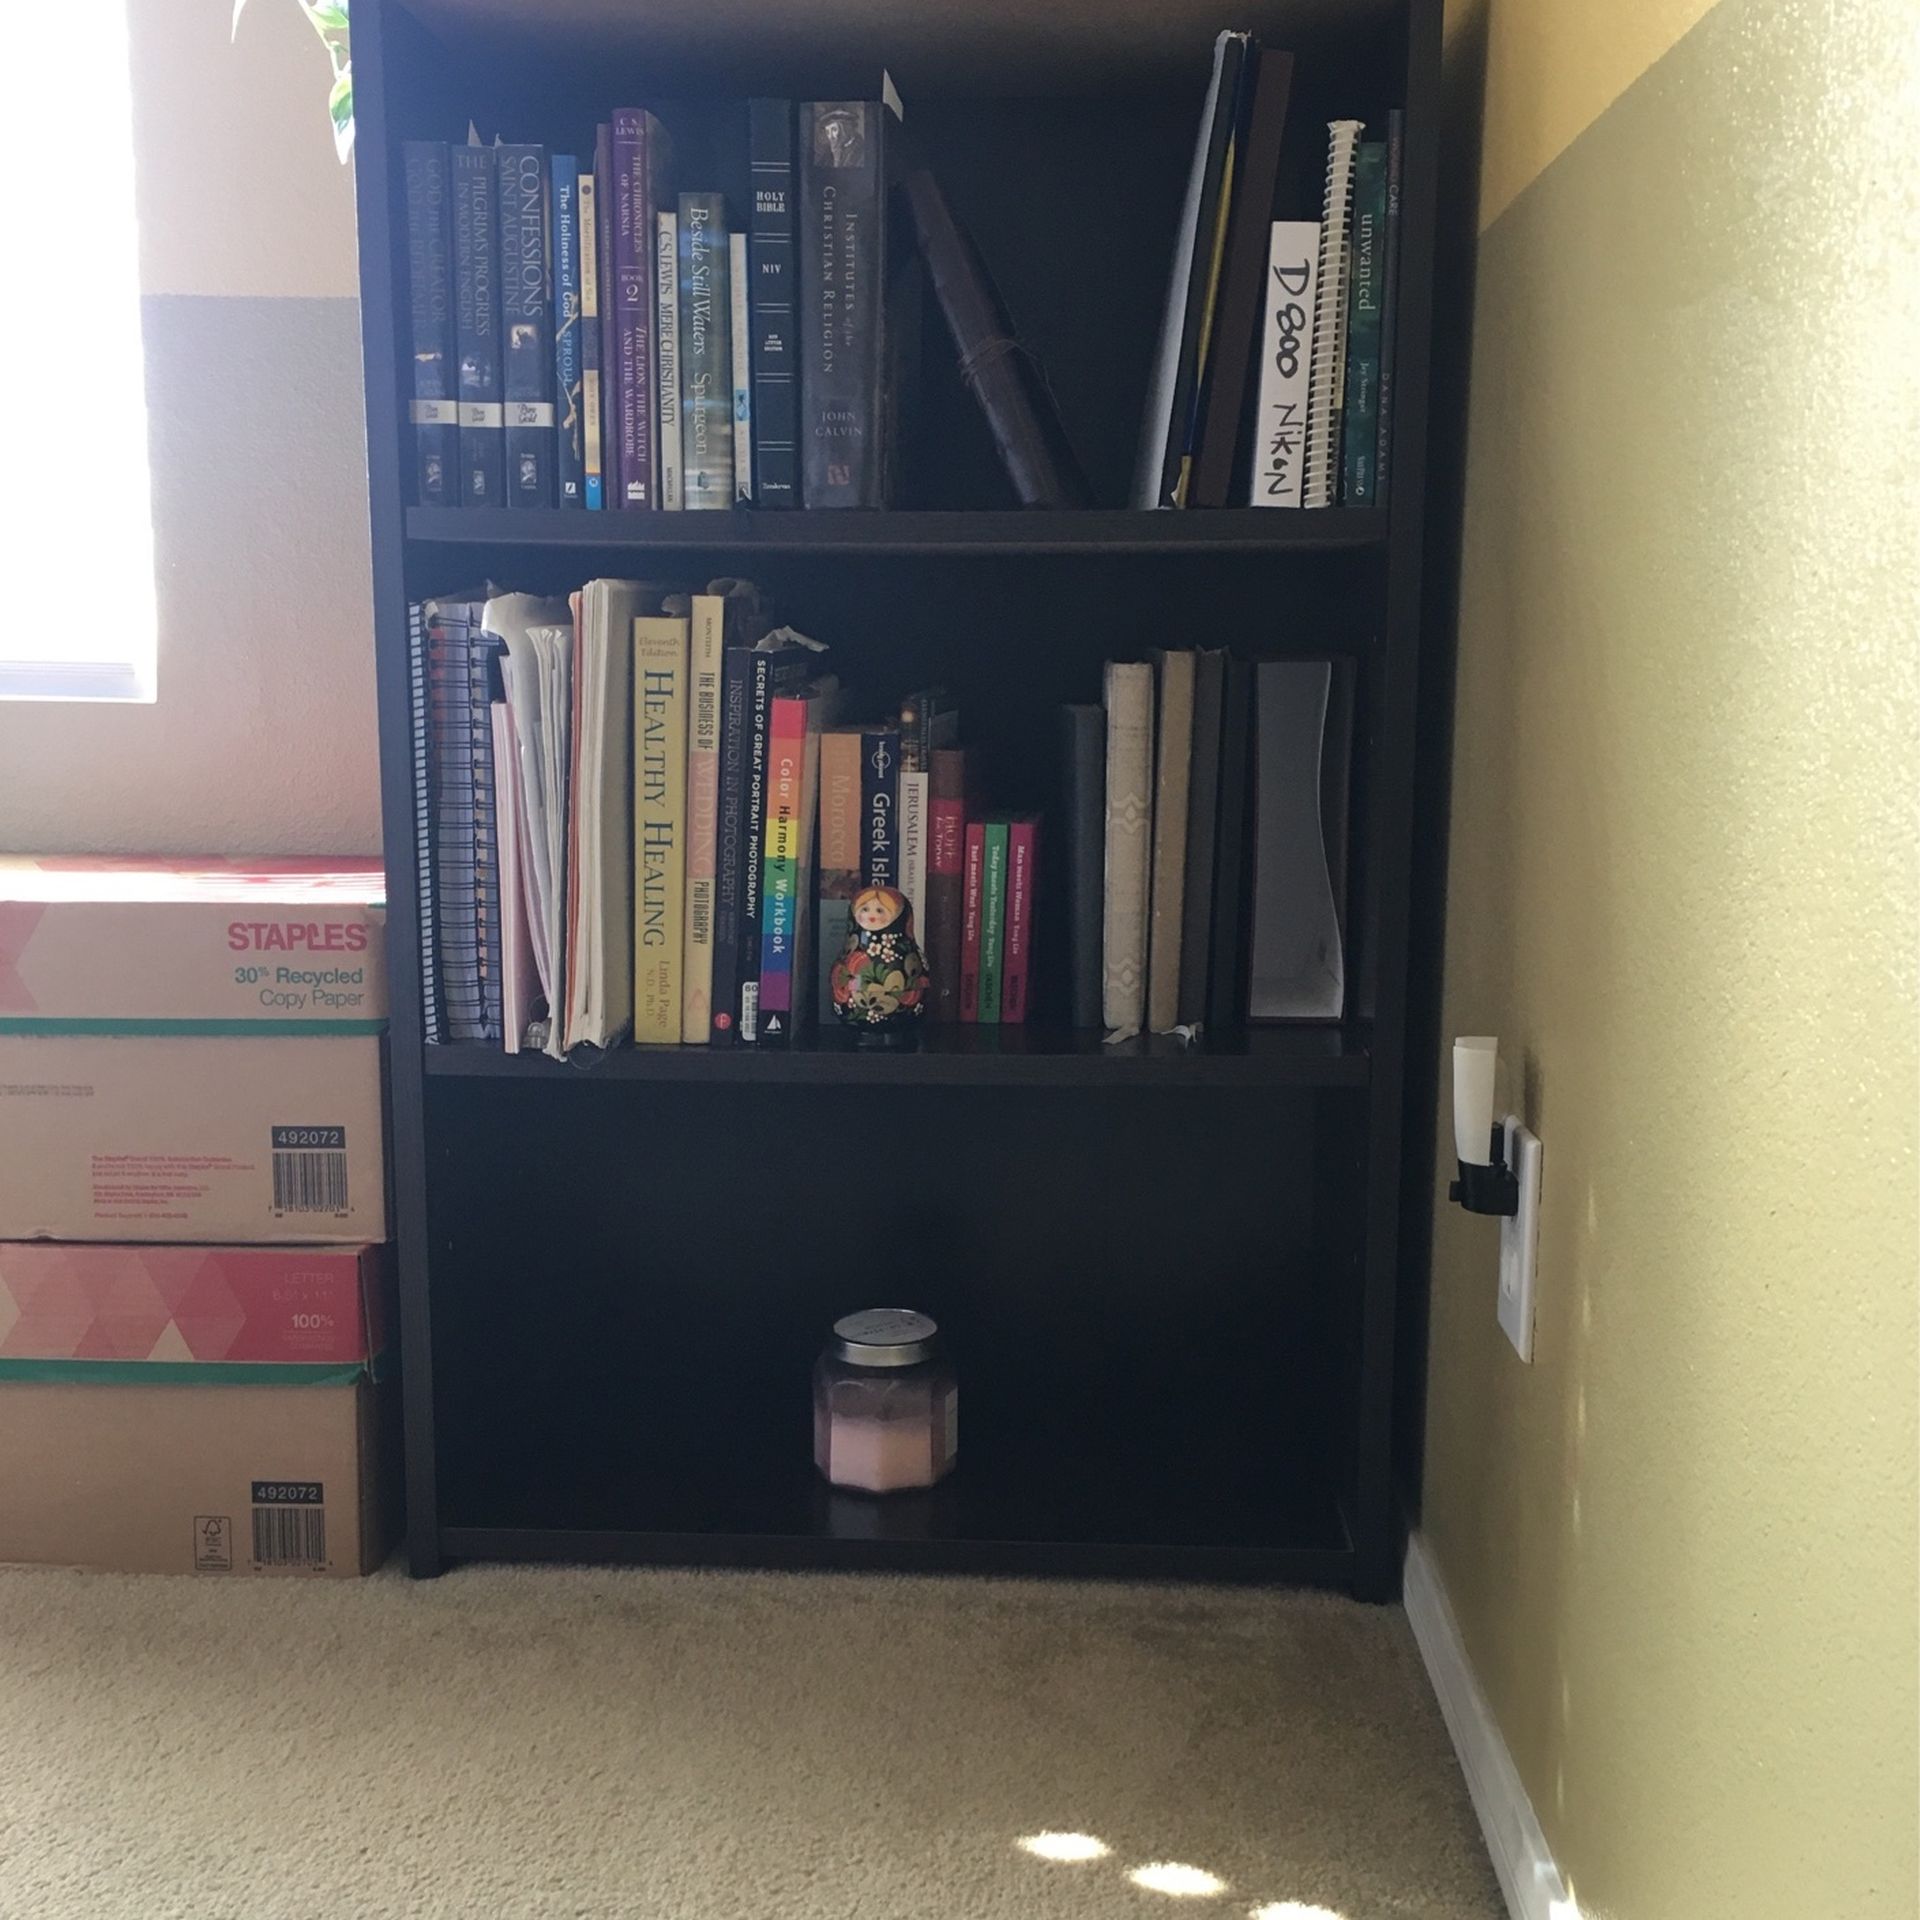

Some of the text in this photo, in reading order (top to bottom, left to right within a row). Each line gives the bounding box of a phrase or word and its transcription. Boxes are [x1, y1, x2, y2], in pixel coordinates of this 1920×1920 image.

[615, 127, 644, 136] LEWIS
[457, 154, 487, 169] THE
[426, 159, 442, 205] GOD
[756, 191, 785, 201] HOLY
[620, 173, 631, 236] OF NARNIA
[632, 155, 643, 253] THE CHRONICLES
[756, 202, 786, 212] BIBLE
[1388, 184, 1400, 217] CARE
[501, 155, 519, 316] SAINT AUGUSTINE
[519, 155, 543, 317] CONFESSIONS
[559, 185, 572, 318] The Holiness of God
[458, 183, 473, 330] IN MODERN ENGLISH
[660, 254, 673, 295] LEWIS
[762, 263, 782, 274] NIV
[845, 213, 858, 311] INSTITUTES
[1358, 213, 1376, 311] unwanted
[429, 239, 447, 323] CREATOR
[621, 273, 643, 282] BOOK
[626, 284, 640, 303] 2
[690, 207, 711, 355] Beside Still Waters
[822, 185, 836, 373] CHRISTIAN RELIGION
[474, 256, 490, 337] PROGRESS
[635, 326, 647, 353] THE
[561, 330, 574, 387] SPROUL
[661, 302, 676, 427] MERE CHRISTIANITY
[623, 328, 635, 458] AND THE WARDROBE
[636, 393, 646, 417] THE
[690, 372, 712, 455] Spurgeon
[815, 425, 863, 437] CALVIN
[822, 411, 856, 423] JOHN
[1377, 372, 1391, 480] DANA ADAMS
[636, 421, 647, 463] WITCH
[639, 636, 680, 646] Eleventh
[641, 647, 679, 657] Edition
[704, 617, 713, 659] MONTEITH
[726, 680, 743, 773] INSPIRATION
[725, 776, 738, 792] IN
[746, 659, 766, 919] SECRETS OF GREAT PORTRAIT PHOTOGRAPHY
[642, 668, 675, 948] HEALTHY HEALING
[692, 672, 715, 945] THE BUSINESS OF WEDDING PHOTOGRAPHY
[831, 775, 851, 863] Morocco
[872, 792, 891, 852] Greek
[906, 782, 920, 856] JERUSALEM
[722, 796, 737, 907] PHOTOGRAPHY
[773, 757, 794, 954] Color Harmony Workbook
[935, 832, 944, 868] TODAY
[944, 816, 958, 859] HOPE
[970, 844, 979, 862] East
[1016, 845, 1025, 864] Man
[969, 863, 978, 887] meets
[990, 845, 1000, 870] Today
[989, 871, 998, 895] meets
[1015, 866, 1023, 890] meets
[968, 888, 977, 908] West
[986, 896, 997, 936] Yesterday
[1013, 891, 1023, 922] Woman
[228, 921, 367, 951] STAPLES
[966, 910, 976, 928] Yang
[1012, 924, 1020, 942] Yang
[986, 937, 995, 954] Yang
[234, 966, 363, 988] 30% Recycled
[657, 959, 671, 1029] Linda Page
[259, 989, 365, 1009] Copy Paper
[278, 1131, 340, 1145] 492072
[284, 1272, 334, 1284] LETTER
[291, 1312, 335, 1329] 100%
[258, 1486, 318, 1500] 492072
